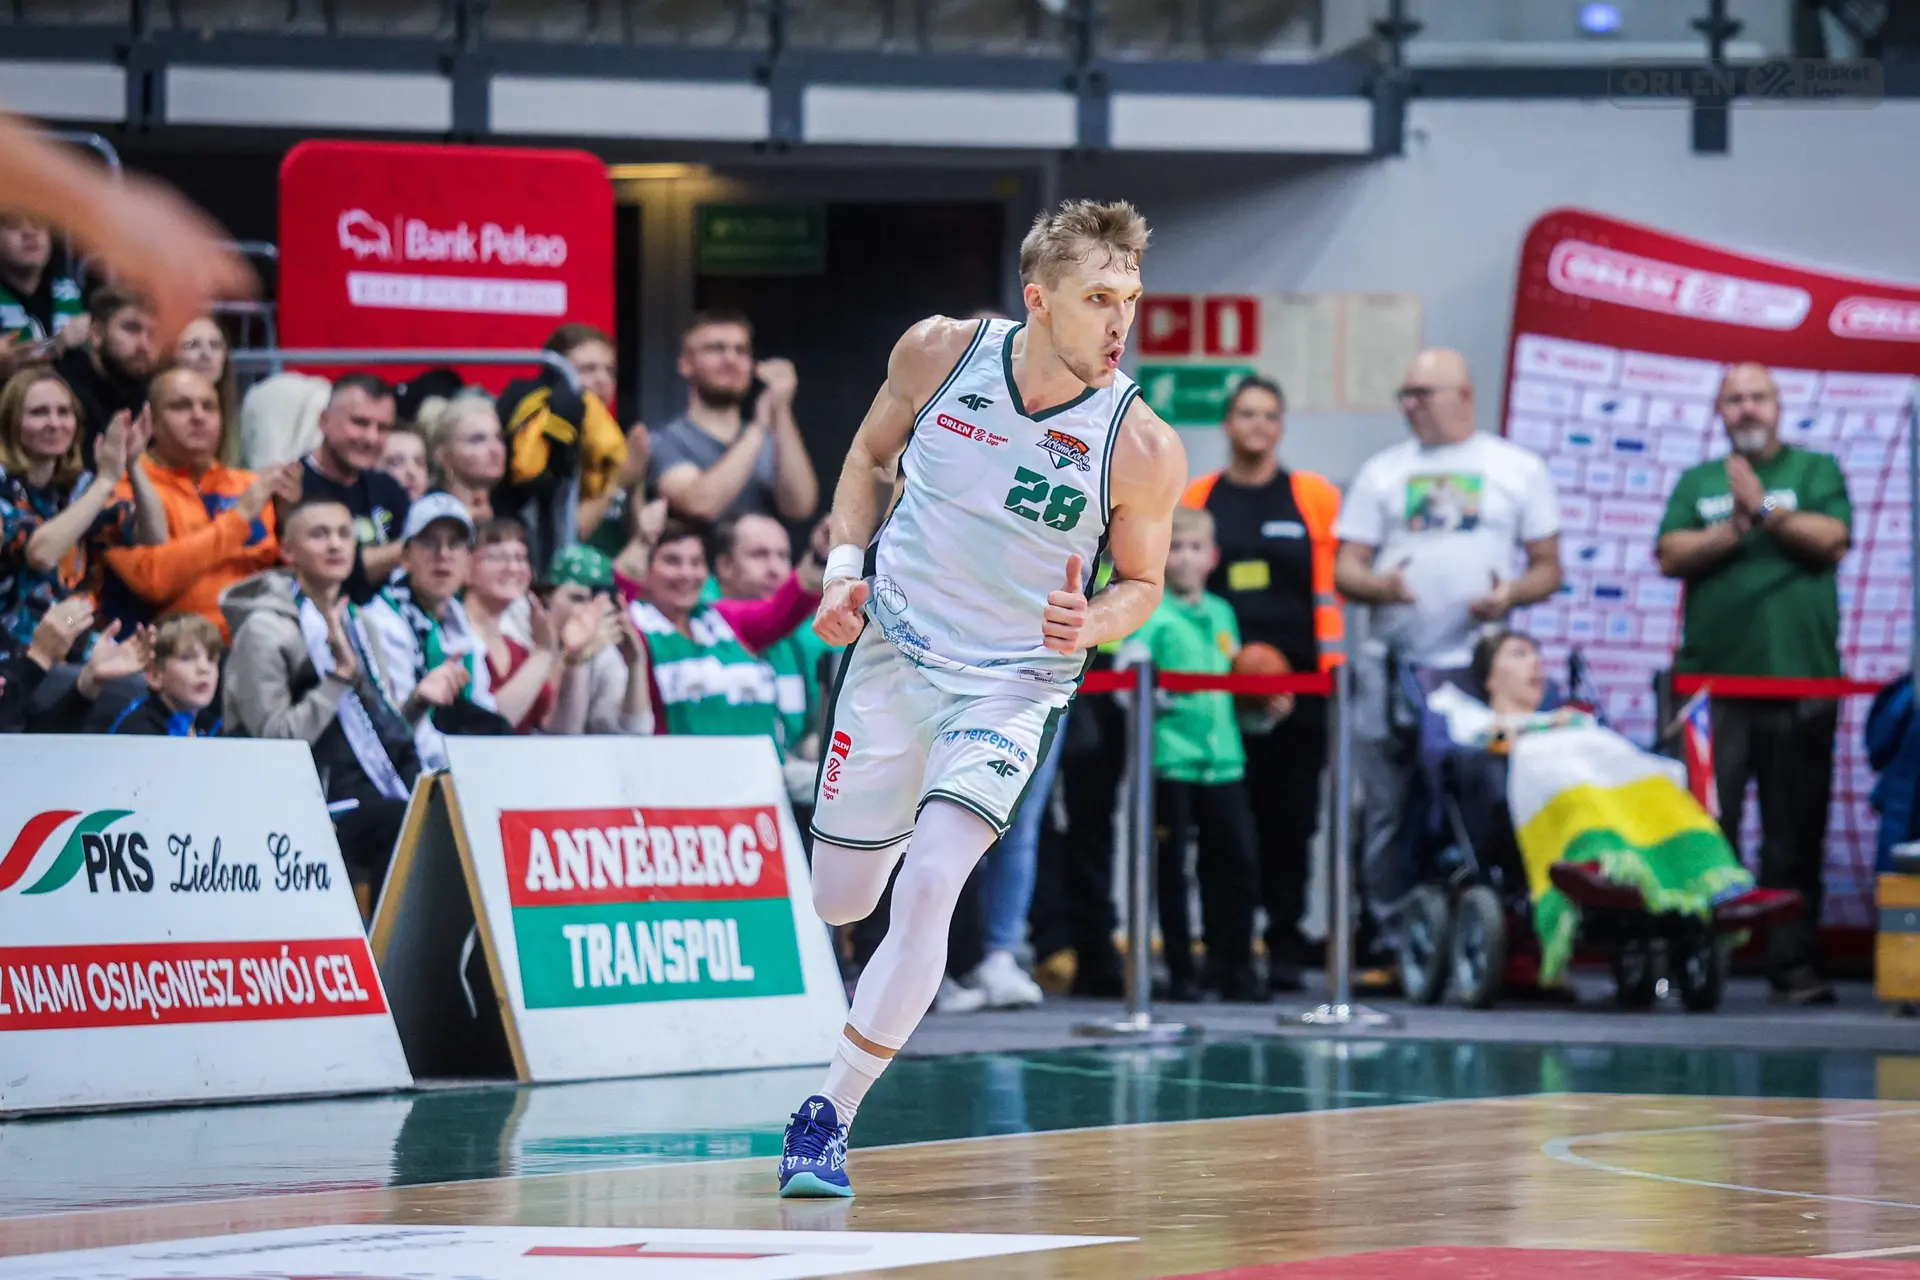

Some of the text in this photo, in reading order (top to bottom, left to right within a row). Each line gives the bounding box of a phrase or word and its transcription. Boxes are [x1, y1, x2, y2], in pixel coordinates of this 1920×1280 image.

[404, 218, 567, 268] Bank Pekao
[939, 416, 972, 435] ORLEN
[957, 393, 995, 411] 4F
[988, 432, 1009, 443] Basket
[1003, 465, 1088, 532] 28
[986, 759, 1020, 778] 4F
[81, 832, 331, 893] PKS Zielona Góra
[562, 918, 755, 988] TRANSPOL
[8, 963, 87, 1014] NAMI
[86, 958, 243, 1020] OSIĄGNIESZ
[239, 945, 314, 1005] SWÓJ
[314, 953, 369, 1003] CEL
